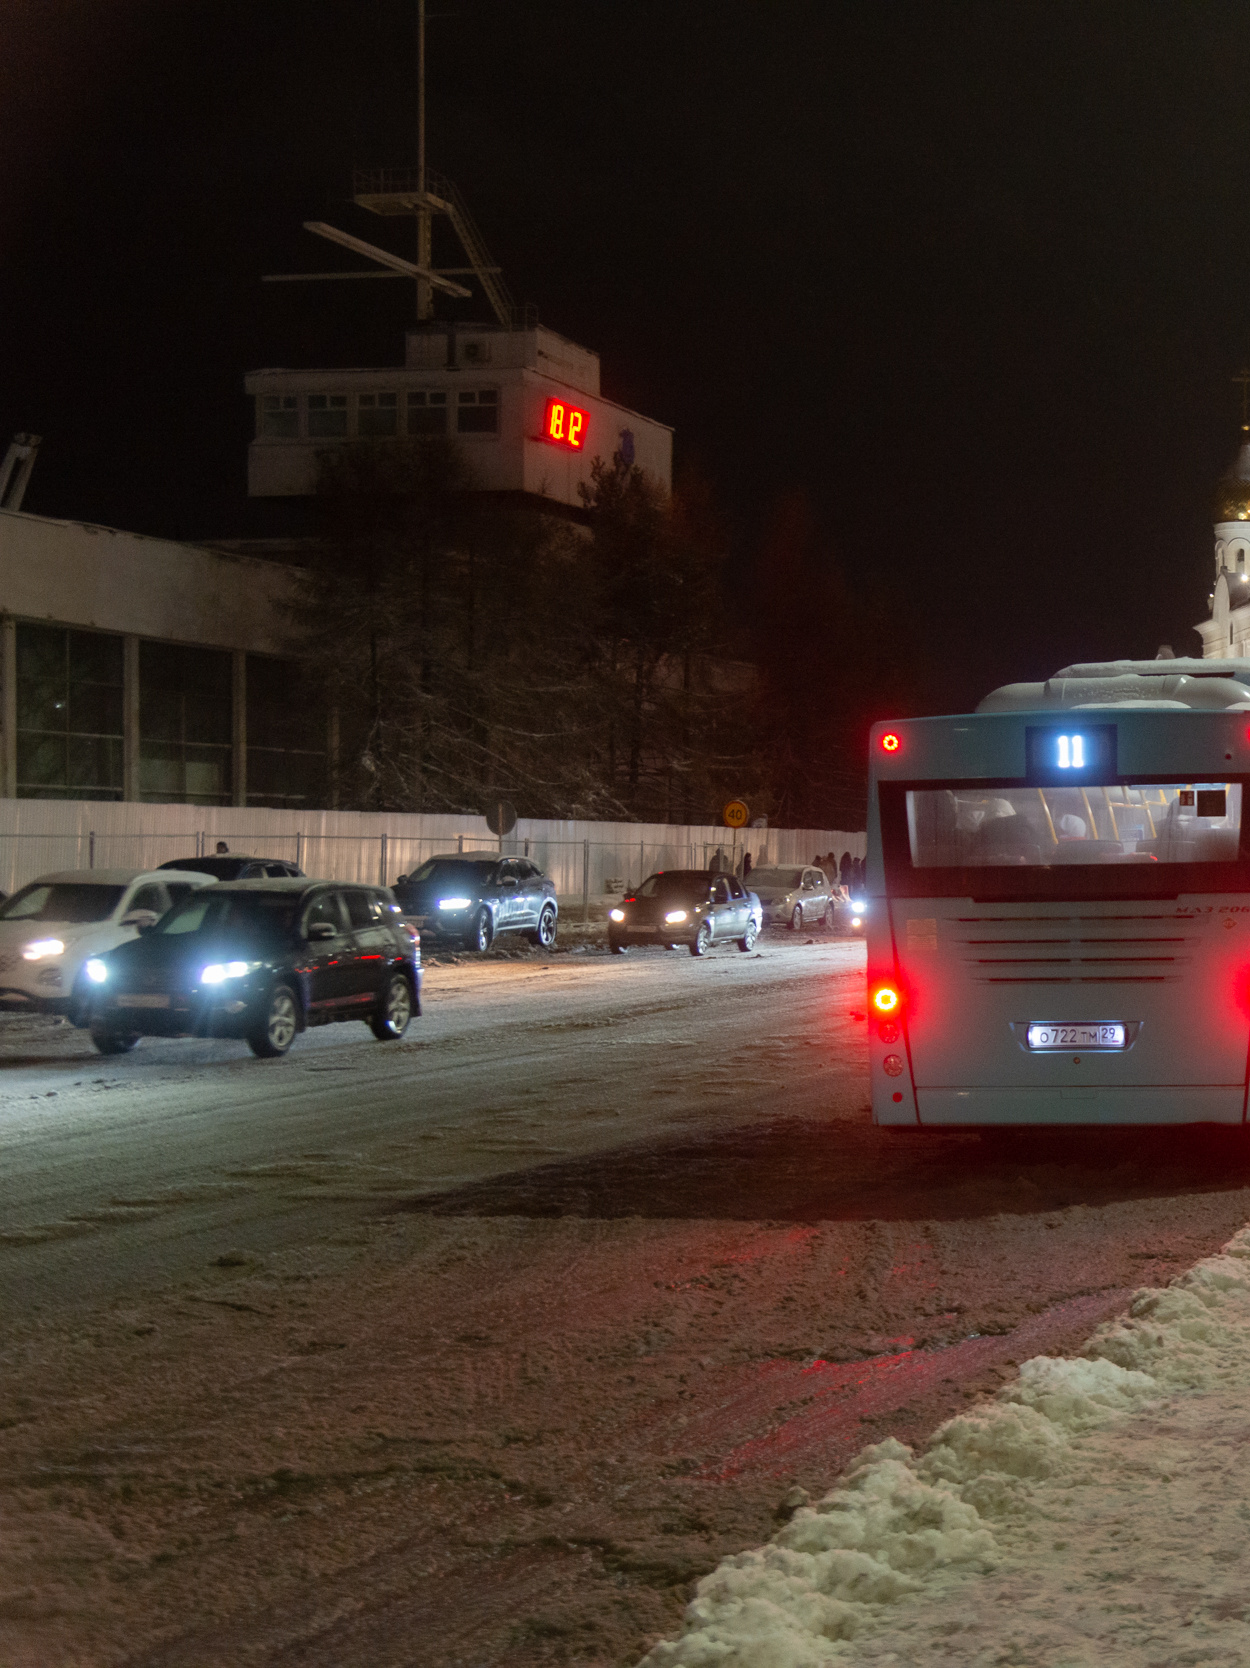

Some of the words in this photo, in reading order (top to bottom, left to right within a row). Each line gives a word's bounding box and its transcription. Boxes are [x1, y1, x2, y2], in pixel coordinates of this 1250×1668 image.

[1058, 735, 1084, 768] 11
[728, 809, 742, 820] 40
[1218, 906, 1250, 914] 206
[1101, 1027, 1116, 1039] 29
